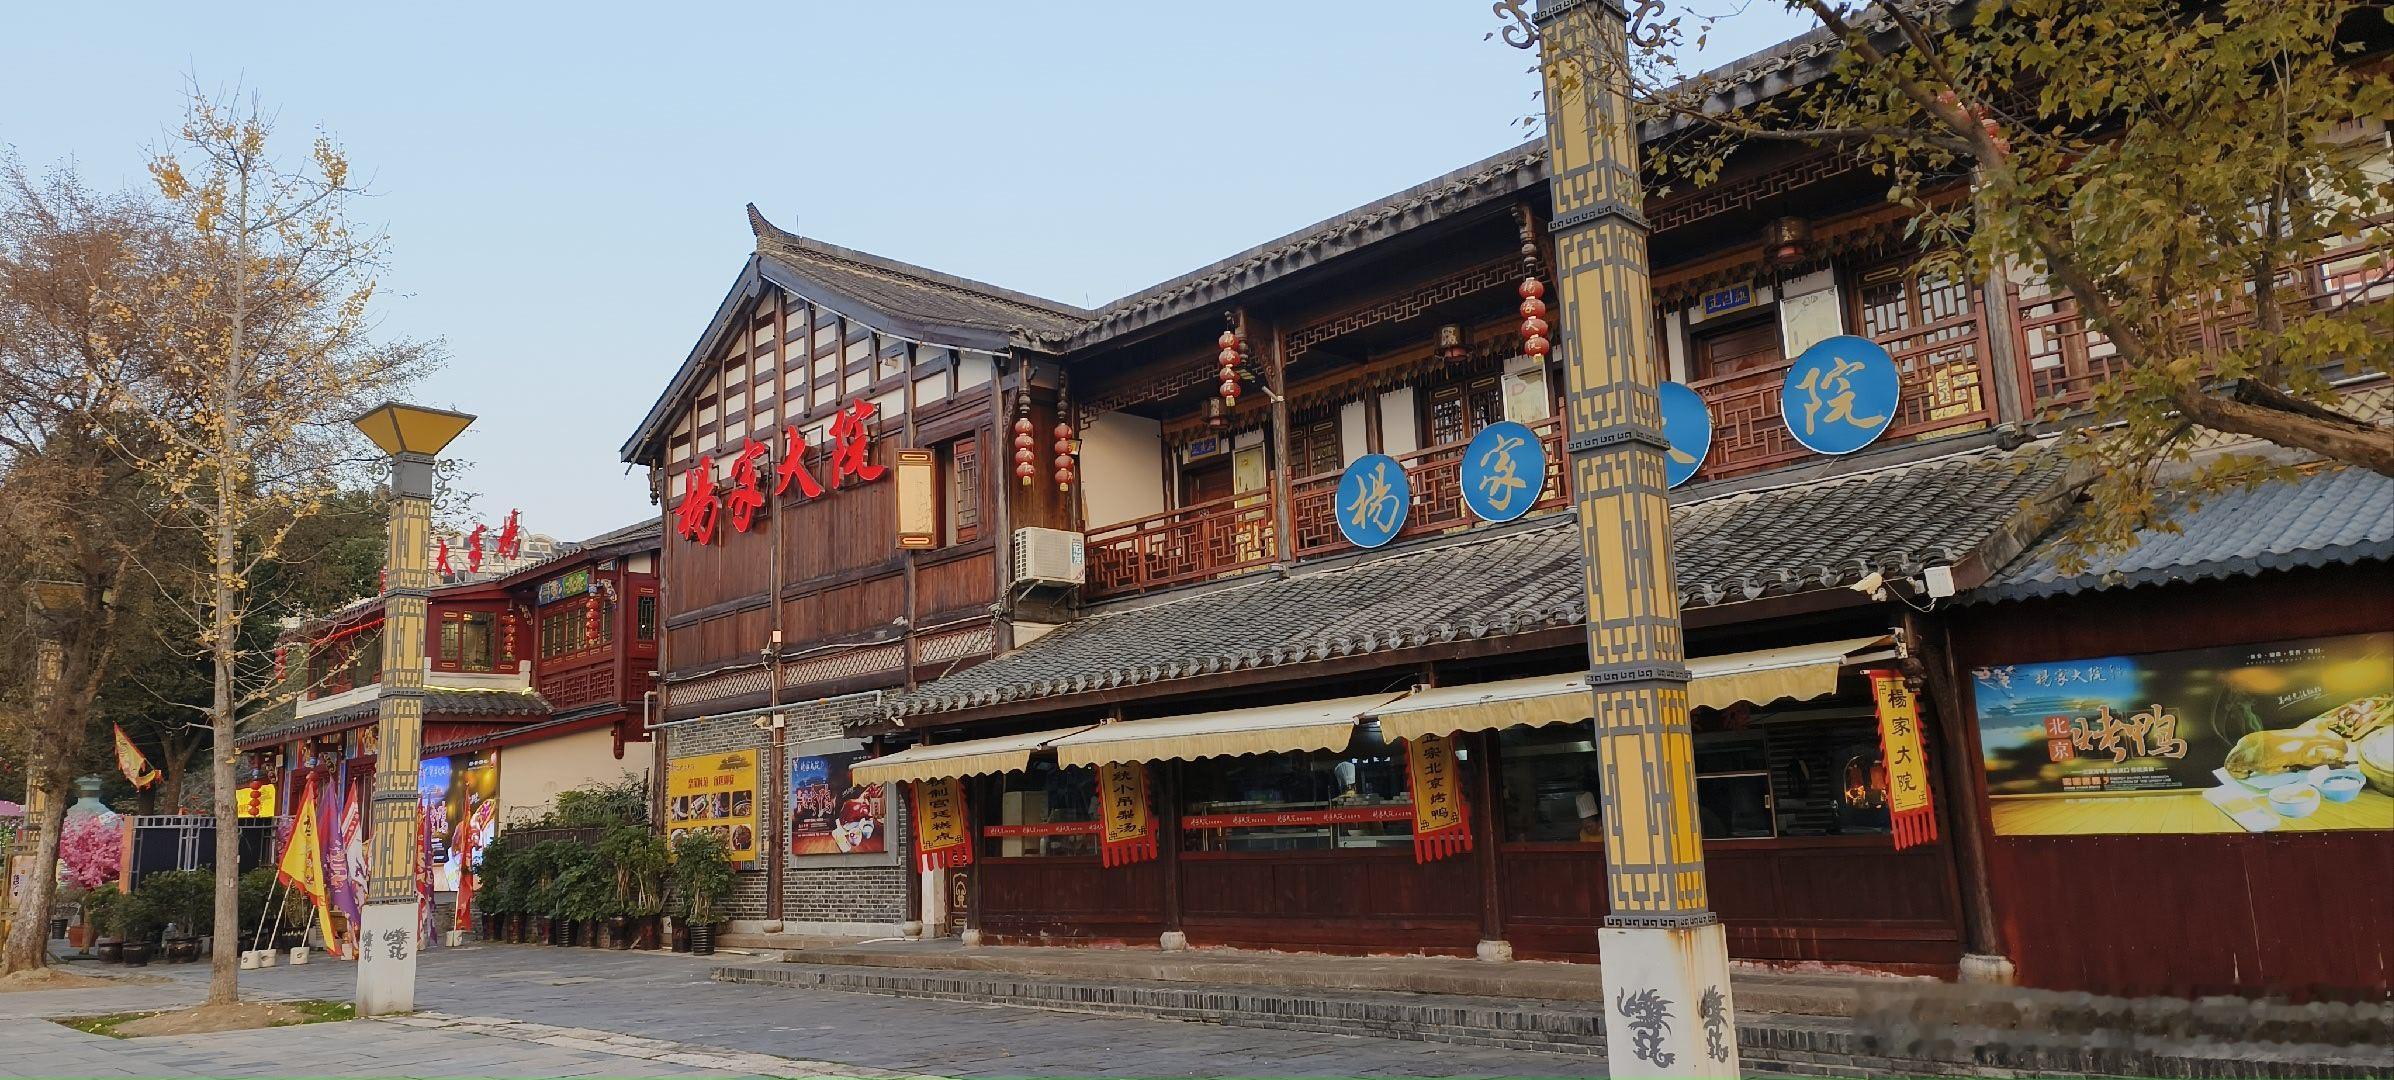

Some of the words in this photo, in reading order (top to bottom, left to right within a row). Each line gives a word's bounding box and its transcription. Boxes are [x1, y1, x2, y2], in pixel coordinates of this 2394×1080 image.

[1795, 357, 1885, 436] 院
[1478, 433, 1528, 512] 家
[1888, 688, 1917, 793] 楊家大院
[2071, 704, 2188, 763] 烤鸭
